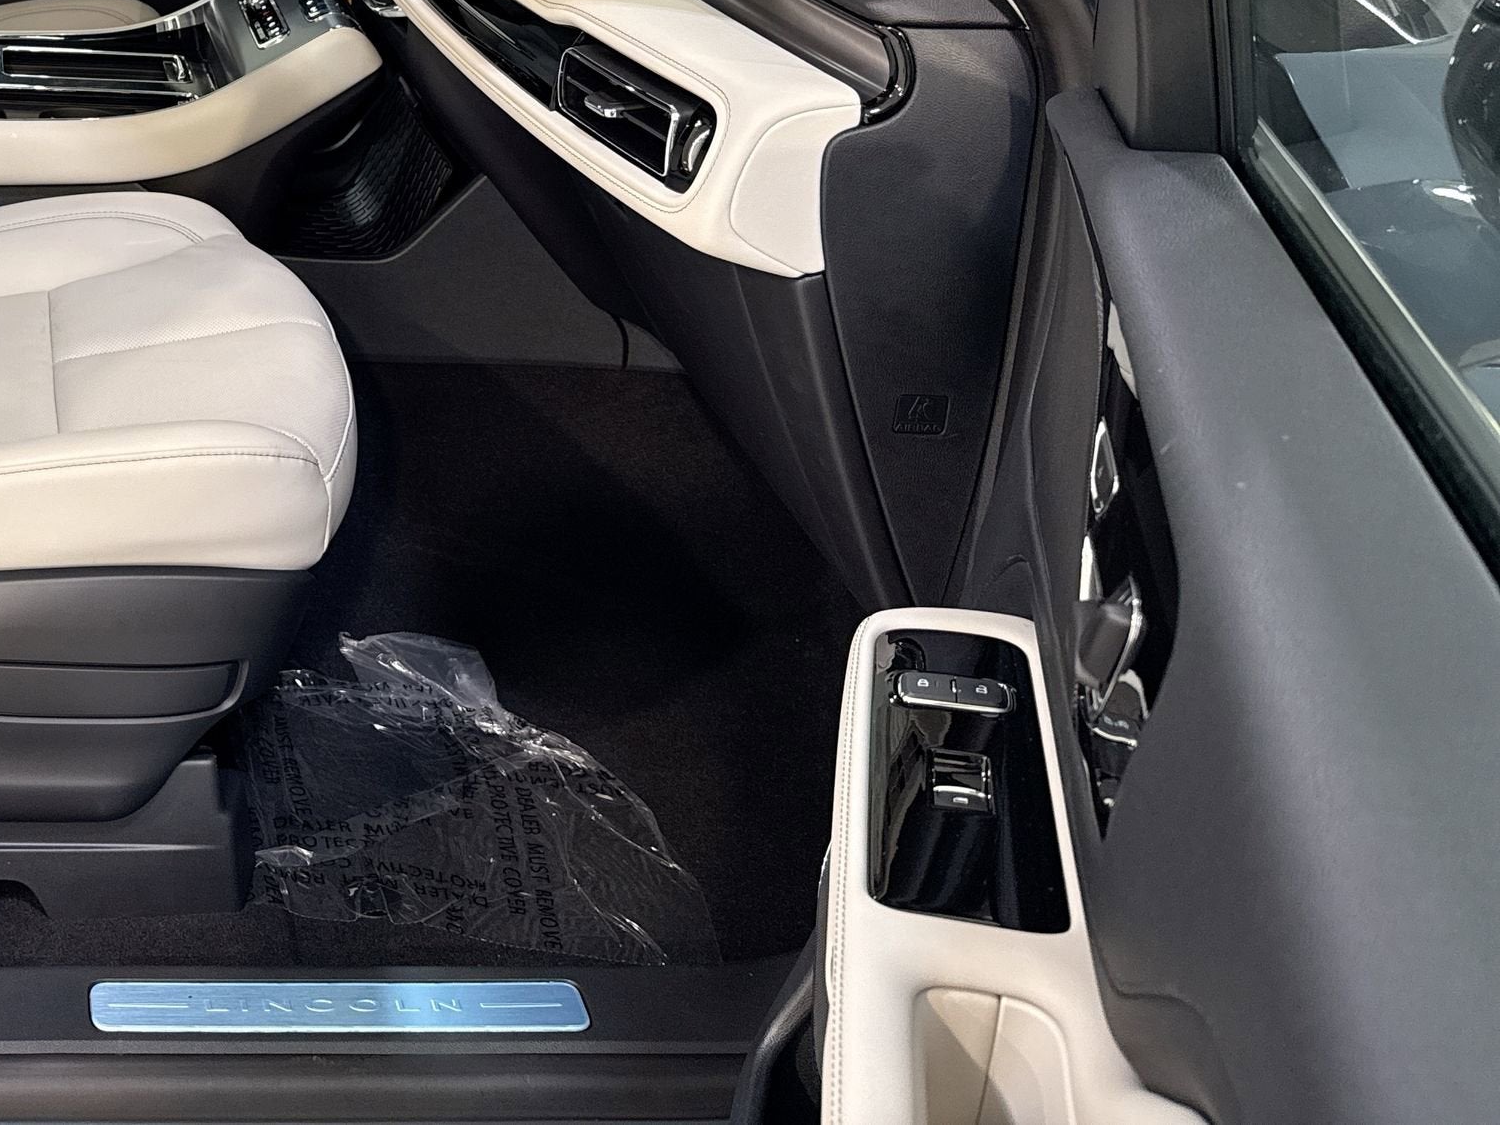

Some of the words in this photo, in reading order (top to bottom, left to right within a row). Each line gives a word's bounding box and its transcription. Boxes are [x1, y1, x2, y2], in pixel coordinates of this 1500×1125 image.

[284, 758, 312, 815] REMOVE
[514, 786, 541, 835] DEALER
[273, 816, 352, 833] DEALER
[489, 784, 518, 863] PROTECTIVE
[527, 842, 550, 883] MUST
[502, 867, 526, 915] COVER
[535, 889, 563, 951] REMOVE
[203, 998, 463, 1012] LINCOLN
